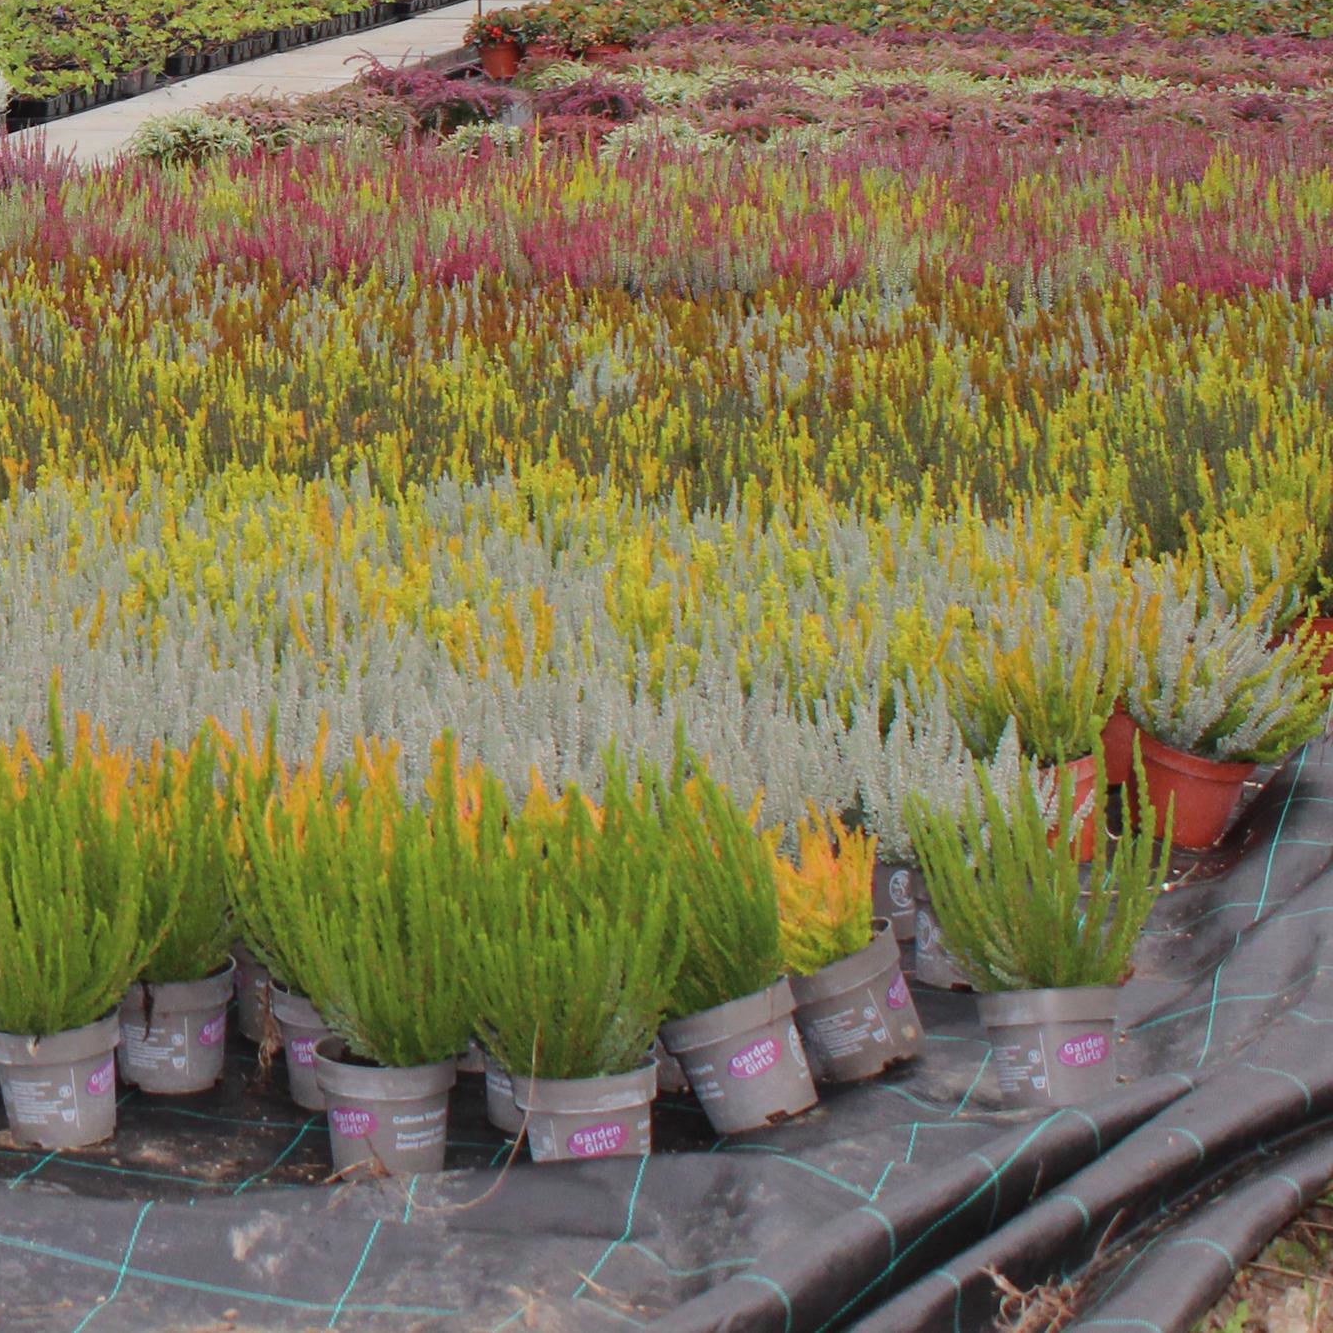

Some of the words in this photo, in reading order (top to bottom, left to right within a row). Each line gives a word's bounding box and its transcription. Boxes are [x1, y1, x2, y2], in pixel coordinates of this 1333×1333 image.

[733, 1040, 774, 1068] Garden
[1064, 1036, 1104, 1054] Garden
[745, 1054, 774, 1075] Girls
[1075, 1049, 1101, 1064] Girls
[574, 1125, 621, 1144] Garden
[585, 1140, 616, 1155] Girls
